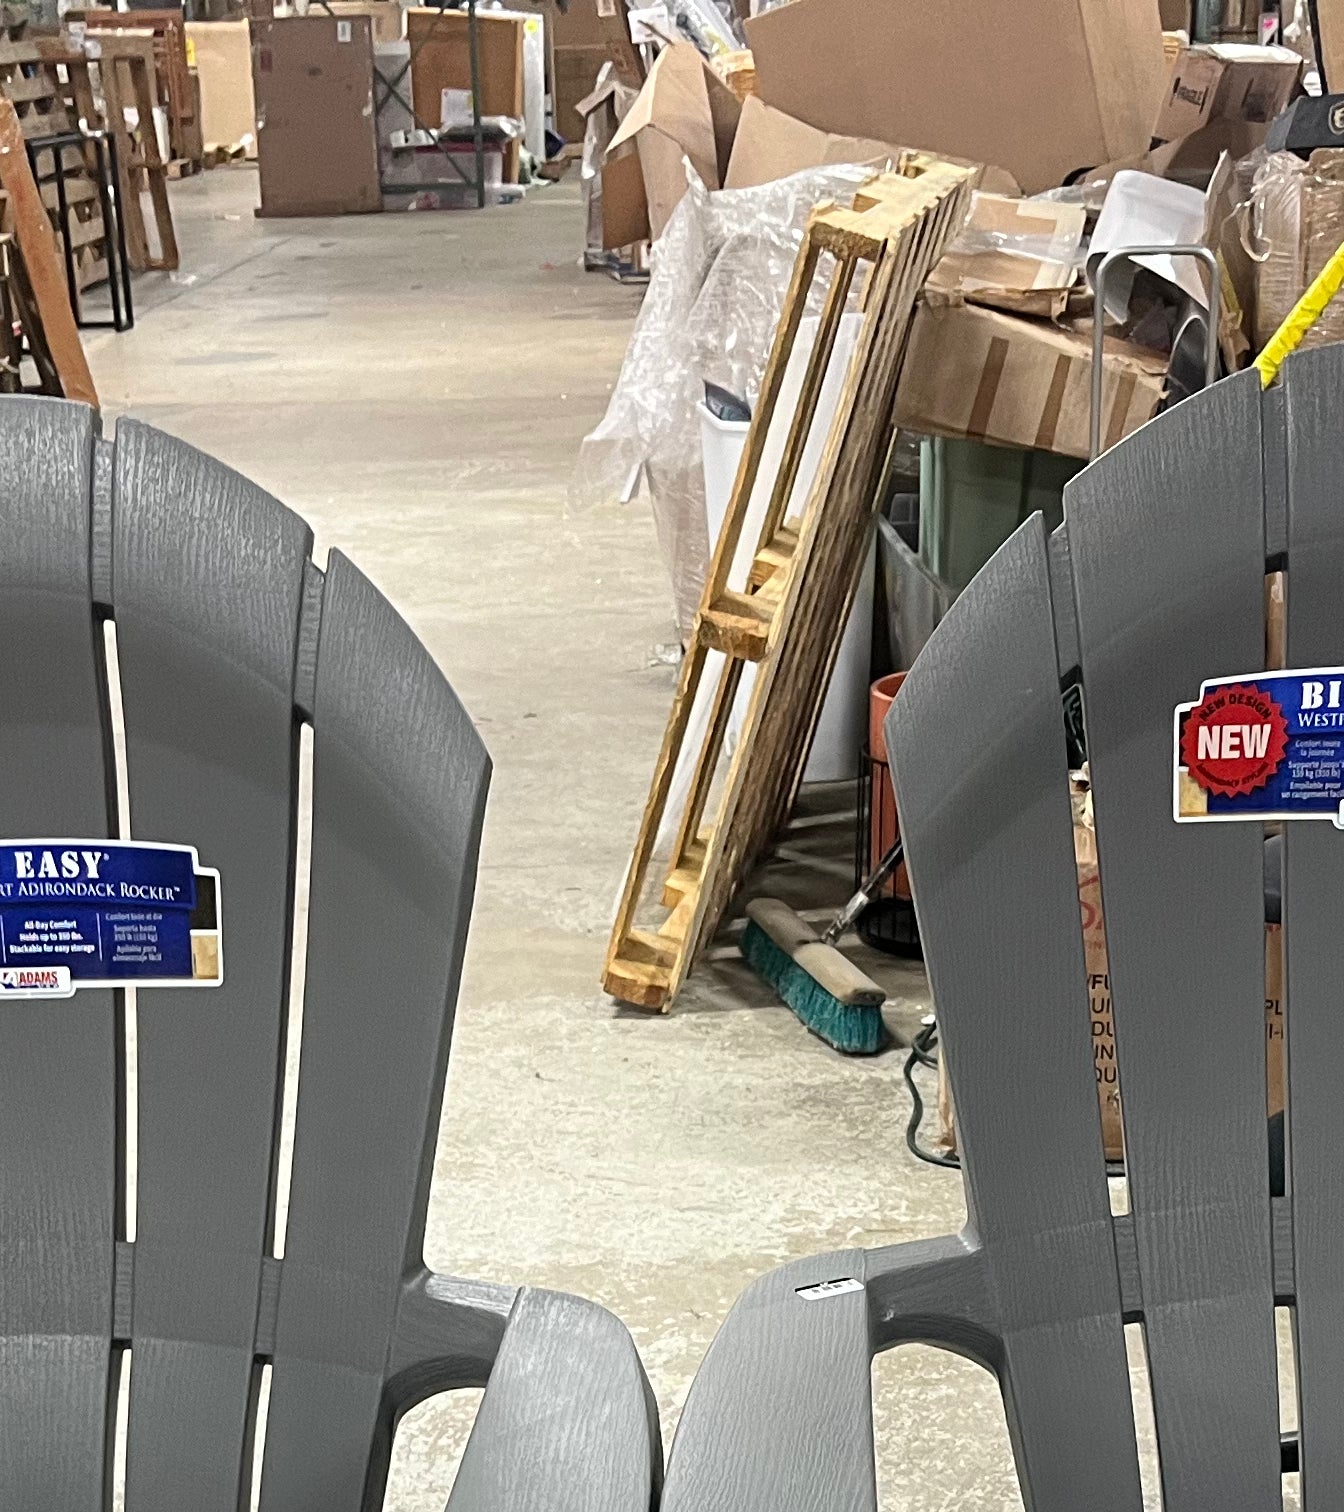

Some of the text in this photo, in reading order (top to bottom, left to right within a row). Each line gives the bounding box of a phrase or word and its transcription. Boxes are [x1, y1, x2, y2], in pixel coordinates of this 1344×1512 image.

[1199, 694, 1271, 721] NEW DESIGN
[1197, 724, 1271, 760] NEW
[18, 882, 115, 898] ADIRONDACK
[19, 971, 58, 984] ADAMS
